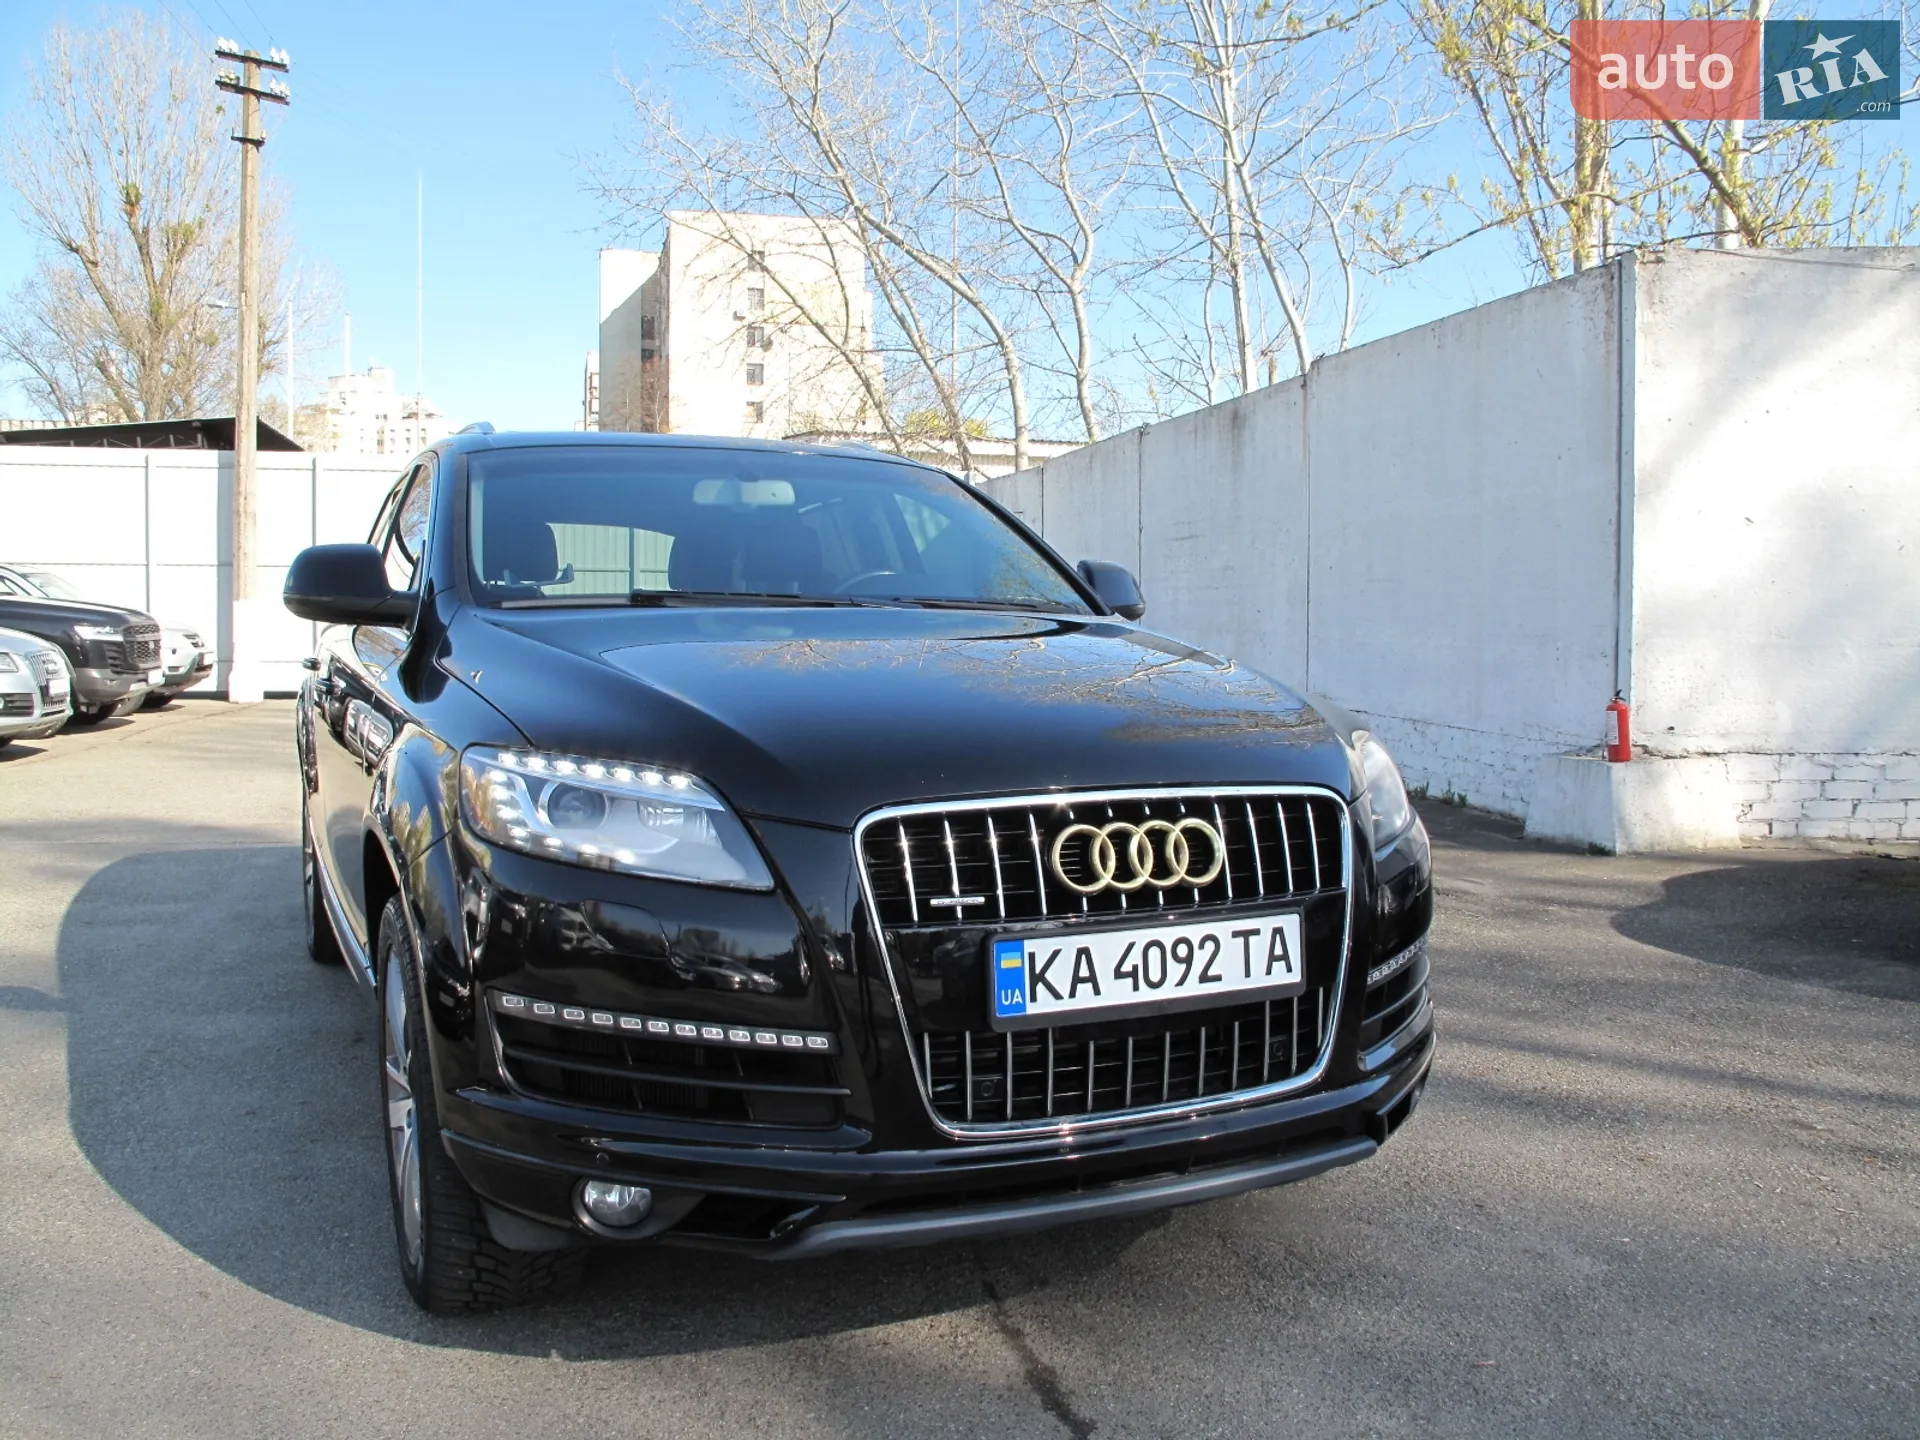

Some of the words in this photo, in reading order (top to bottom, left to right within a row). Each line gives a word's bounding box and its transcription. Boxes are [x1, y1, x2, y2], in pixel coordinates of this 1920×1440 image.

[1027, 946, 1101, 1003] KA
[1113, 933, 1223, 992] 4092
[1231, 926, 1293, 979] TA
[1001, 987, 1024, 1006] UA
